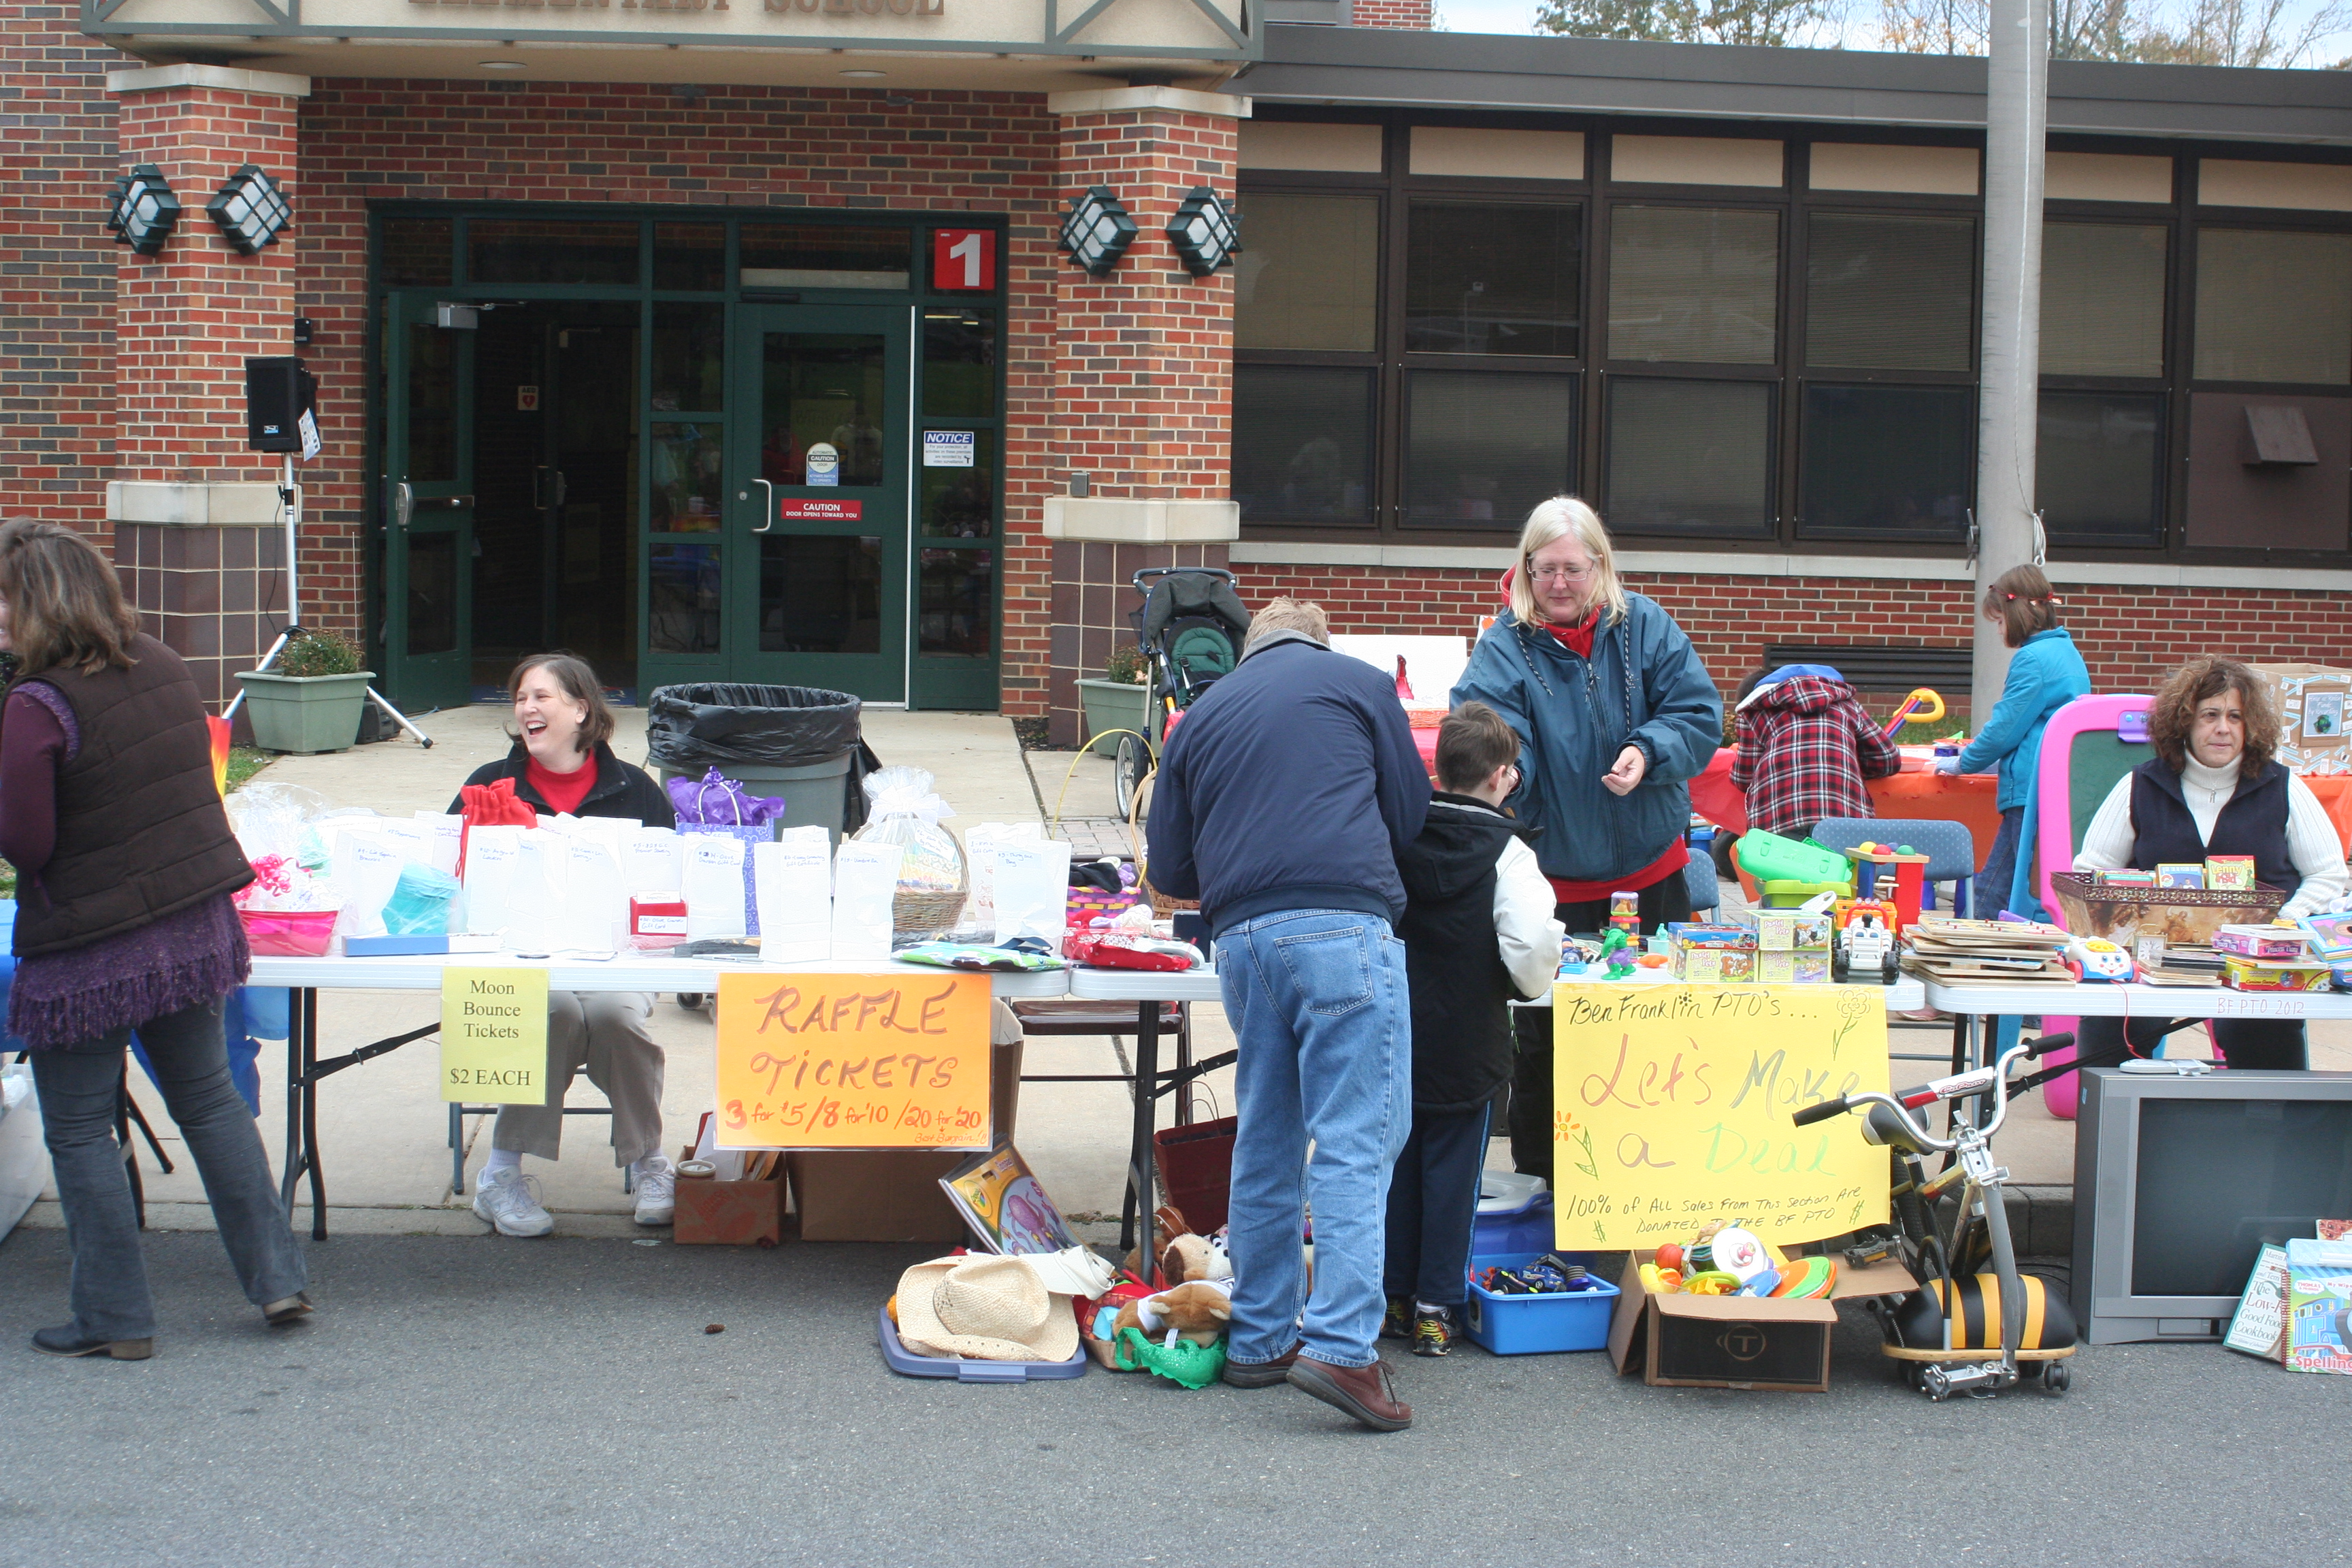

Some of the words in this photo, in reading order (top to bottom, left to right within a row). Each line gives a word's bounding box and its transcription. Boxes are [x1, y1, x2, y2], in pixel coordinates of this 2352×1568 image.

[950, 233, 981, 287] 1
[927, 434, 971, 443] NOTICE
[803, 503, 840, 512] CAUTION
[2211, 864, 2244, 876] Lenny
[1764, 919, 1784, 928] Pastel
[1776, 926, 1791, 936] Pets
[1690, 951, 1711, 961] Pastel
[1702, 958, 1717, 968] Pets
[1764, 953, 1784, 962] Pastel
[1776, 959, 1791, 968] Pets
[470, 980, 515, 995] Moon
[463, 1001, 521, 1017] Bounce
[753, 980, 958, 1035] RAFFLE
[1568, 996, 1613, 1026] Ben
[1617, 992, 1704, 1022] Franklin
[2217, 997, 2234, 1014] BF
[2240, 998, 2268, 1015] PTO
[2274, 1000, 2305, 1015] 2012
[463, 1023, 520, 1039] Tickets
[450, 1068, 470, 1085] $2
[475, 1069, 532, 1086] EACH
[749, 1049, 959, 1096] TICKETS
[1580, 1032, 1713, 1109] Let's
[1729, 1049, 1867, 1126] Make
[725, 1099, 748, 1130] 3
[751, 1102, 775, 1123] for
[845, 1106, 866, 1124] for
[935, 1109, 954, 1126] for
[915, 1132, 935, 1143] Best
[1616, 1132, 1676, 1169] a
[1697, 1122, 1837, 1177] Deal
[1567, 1194, 1612, 1220] 100%
[1623, 1196, 1641, 1214] of
[1682, 1198, 1714, 1212] Sales
[1756, 1198, 1780, 1211] This
[1787, 1194, 1829, 1209] Section
[1838, 1185, 1861, 1200] Are
[1636, 1217, 1700, 1234] DONATED
[1735, 1216, 1765, 1228] THE
[1775, 1213, 1797, 1226] BF
[1803, 1207, 1835, 1222] PTO
[2252, 1279, 2271, 1294] The
[2240, 1308, 2266, 1324] Good
[2234, 1321, 2277, 1341] Cookbook
